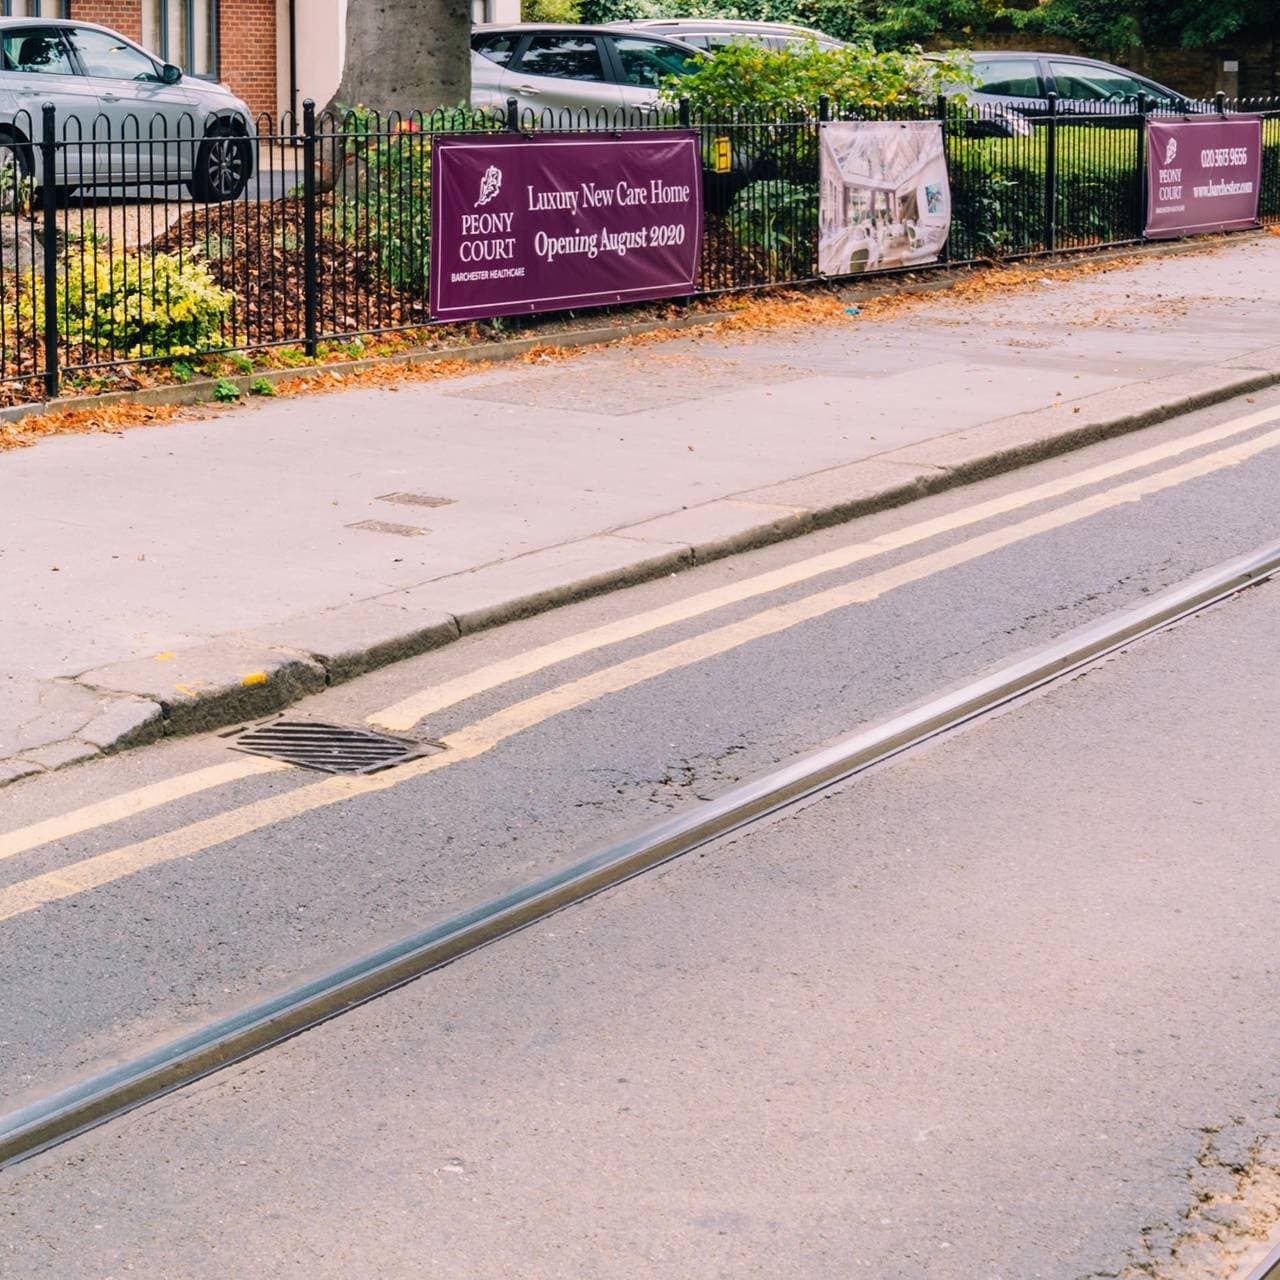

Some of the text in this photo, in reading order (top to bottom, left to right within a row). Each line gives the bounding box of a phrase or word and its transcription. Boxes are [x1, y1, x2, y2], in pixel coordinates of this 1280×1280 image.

[1201, 149, 1215, 168] 020
[1159, 168, 1182, 183] PEONY
[527, 180, 690, 215] Luxury New Care Home
[1159, 186, 1182, 200] COURT
[461, 212, 514, 235] PEONY
[459, 238, 516, 262] COURT
[534, 224, 684, 262] Opening August 2020
[451, 267, 525, 283] BARCHESTER HEALTHCARE
